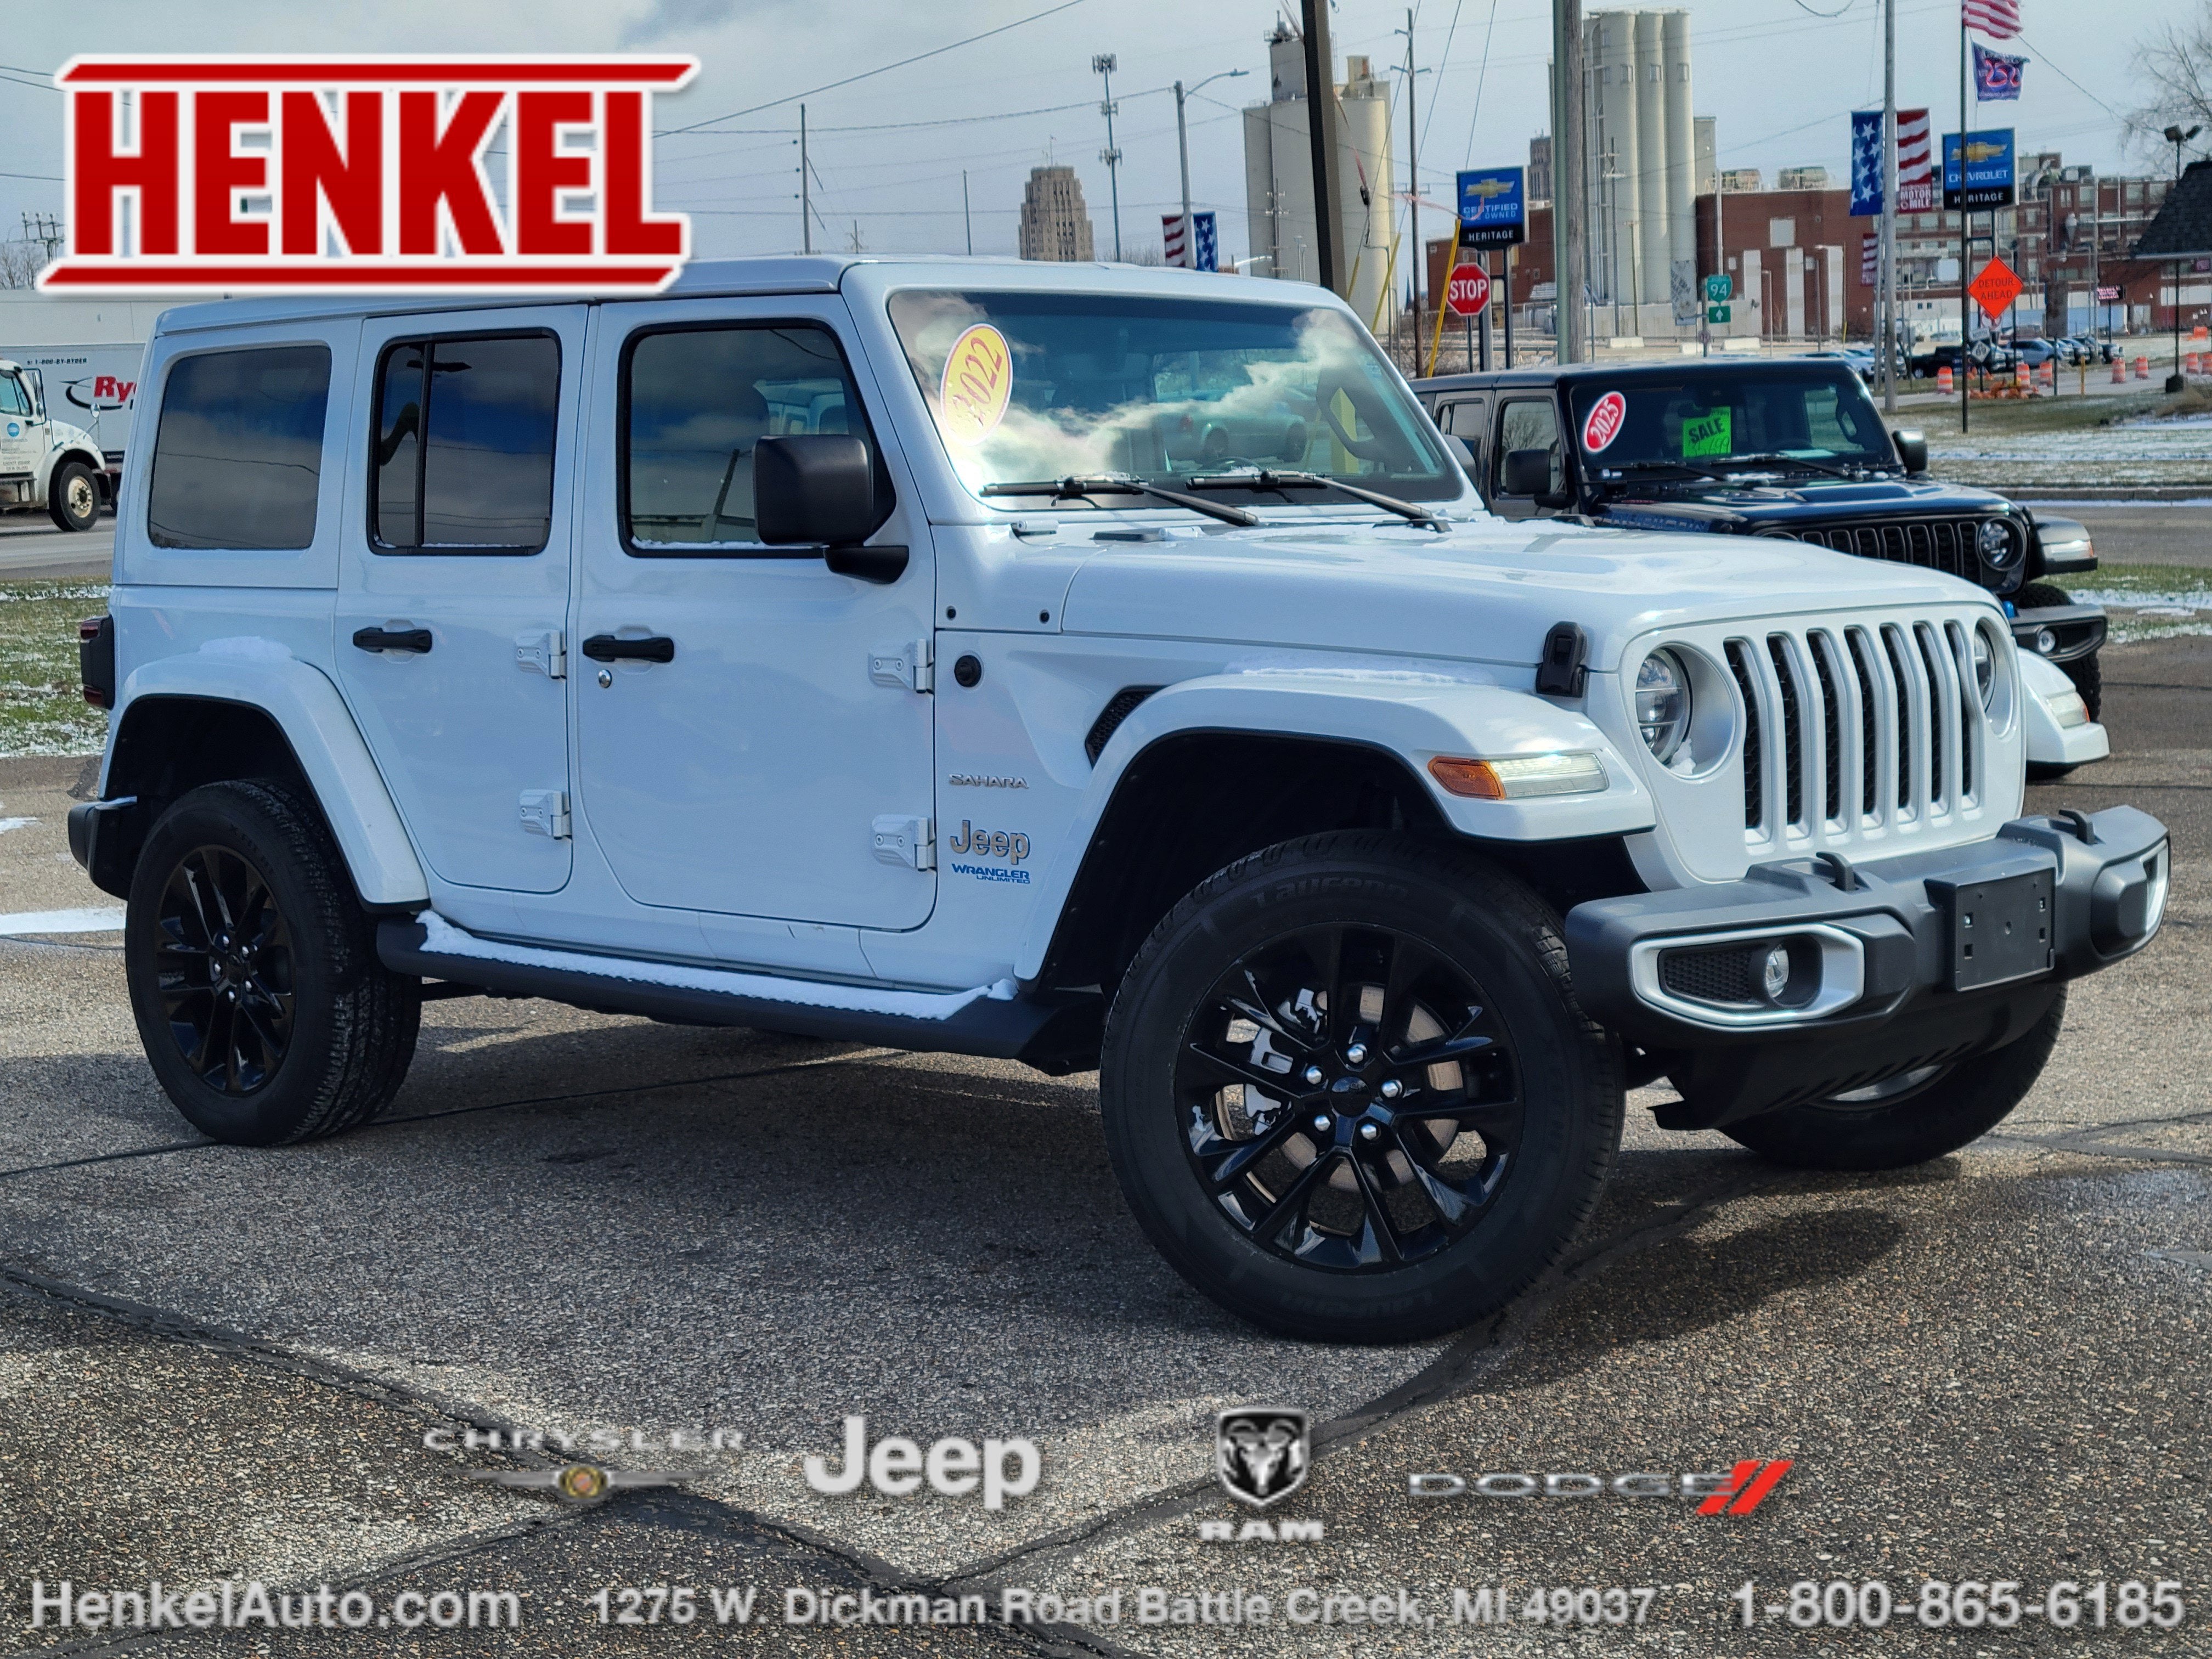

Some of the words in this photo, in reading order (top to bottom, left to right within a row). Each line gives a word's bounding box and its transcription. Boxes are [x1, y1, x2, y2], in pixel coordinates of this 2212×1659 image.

[1948, 170, 2008, 183] CHVROLET
[1900, 189, 1931, 200] MOTOR
[1954, 192, 2004, 204] HRITAGE
[1909, 198, 1931, 210] MILE
[1469, 229, 1514, 241] HERITAGE
[1450, 279, 1487, 301] STOP
[1710, 283, 1727, 297] 94
[1978, 277, 2013, 289] DETOUR
[1980, 290, 2013, 301] AHEAD
[952, 336, 1003, 427] 2022
[94, 375, 137, 403] Ry
[1590, 398, 1619, 445] 2025
[1688, 417, 1726, 444] SALE
[949, 774, 1030, 789] SAHARA
[949, 820, 1031, 865] Jeep
[951, 863, 1030, 879] WRANGLER
[976, 875, 1031, 884] UNLIMITED
